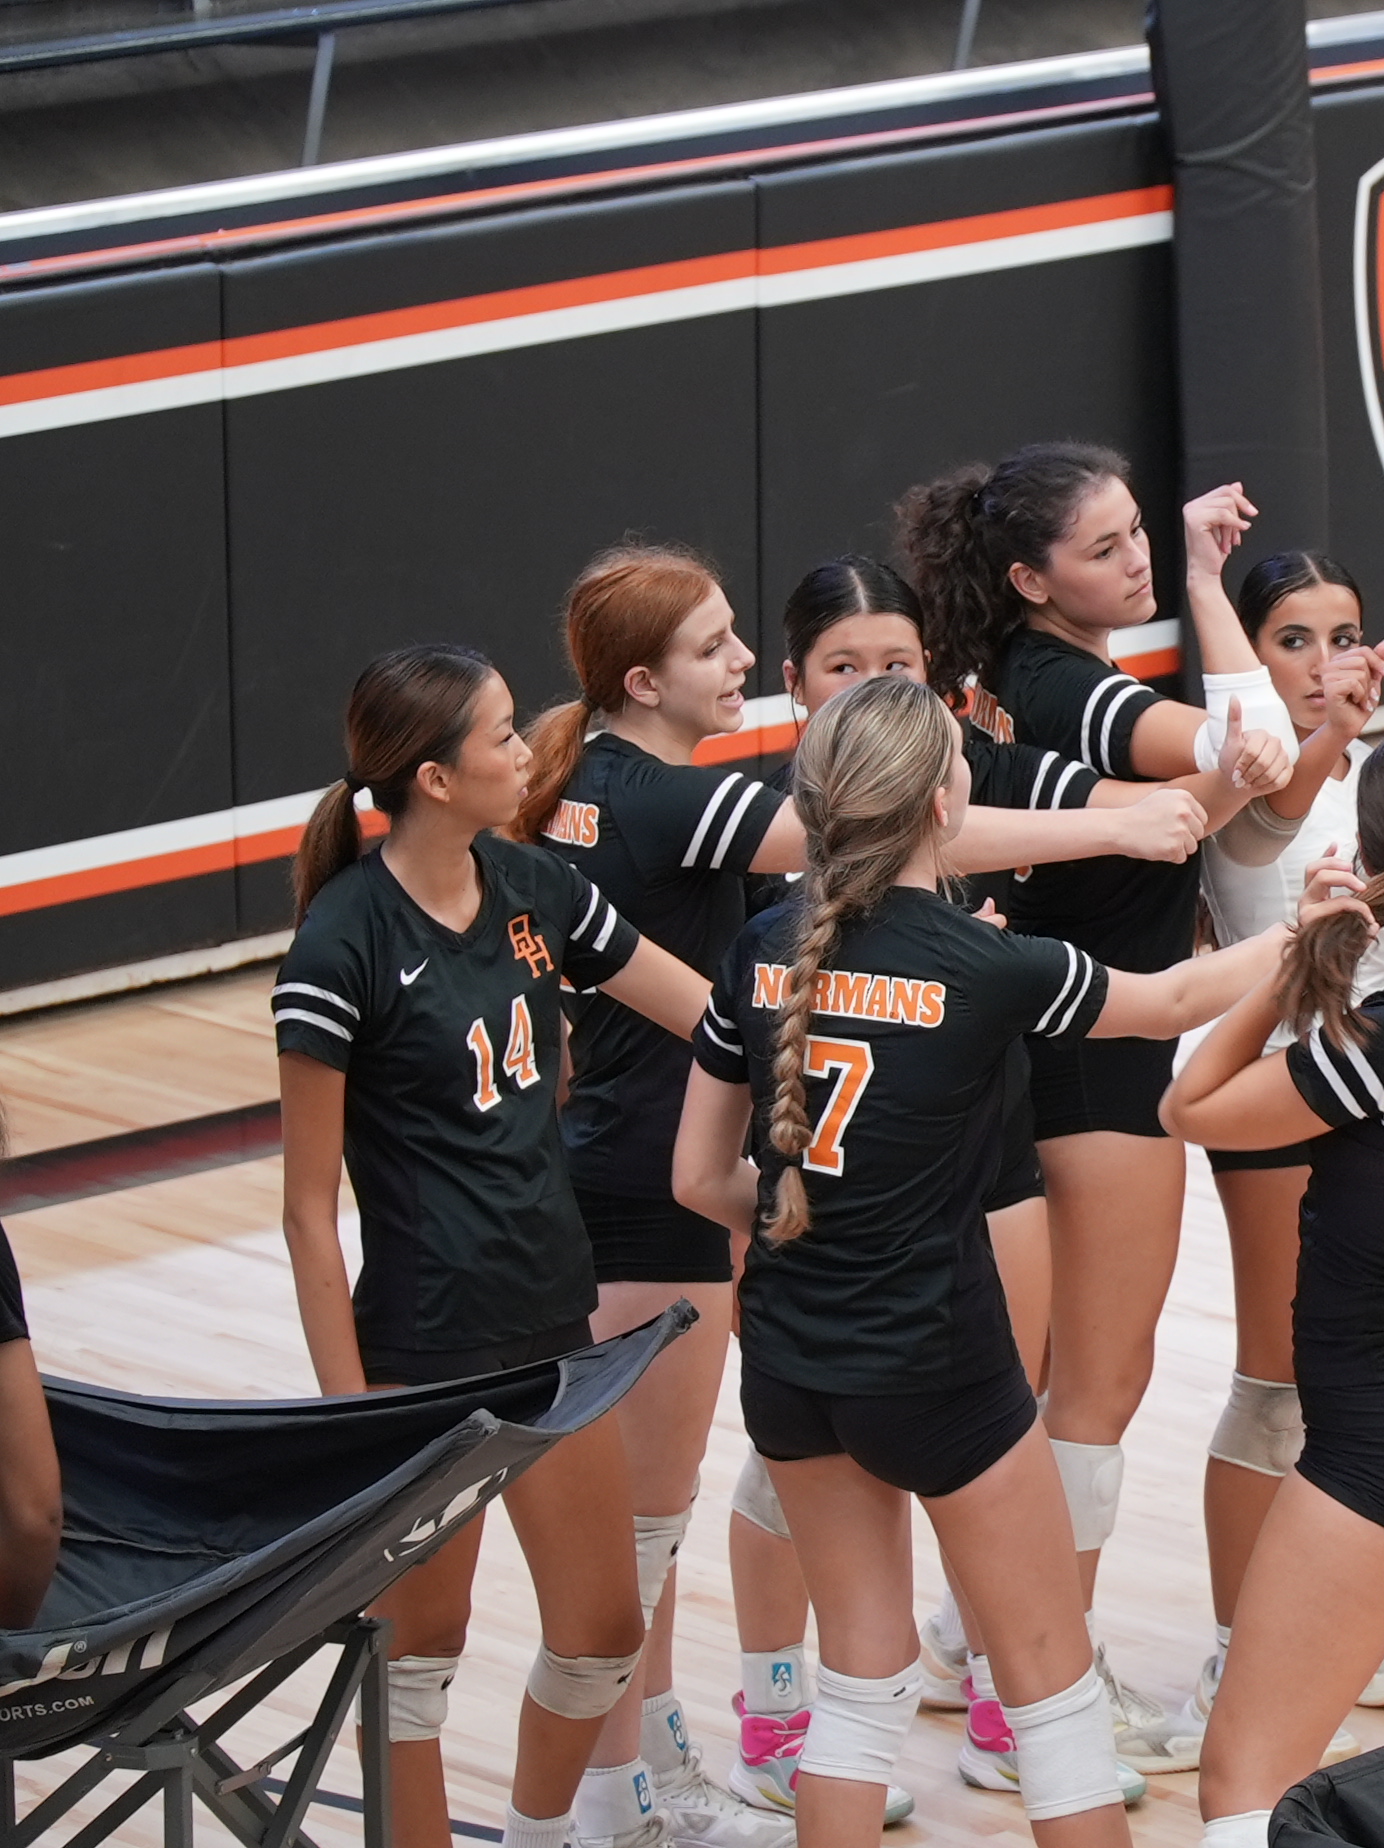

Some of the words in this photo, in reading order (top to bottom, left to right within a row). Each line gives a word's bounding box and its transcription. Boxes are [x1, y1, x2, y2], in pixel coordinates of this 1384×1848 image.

[466, 993, 541, 1112] 14
[802, 1034, 875, 1177] 7
[0, 1695, 95, 1721] ORTS.COM
